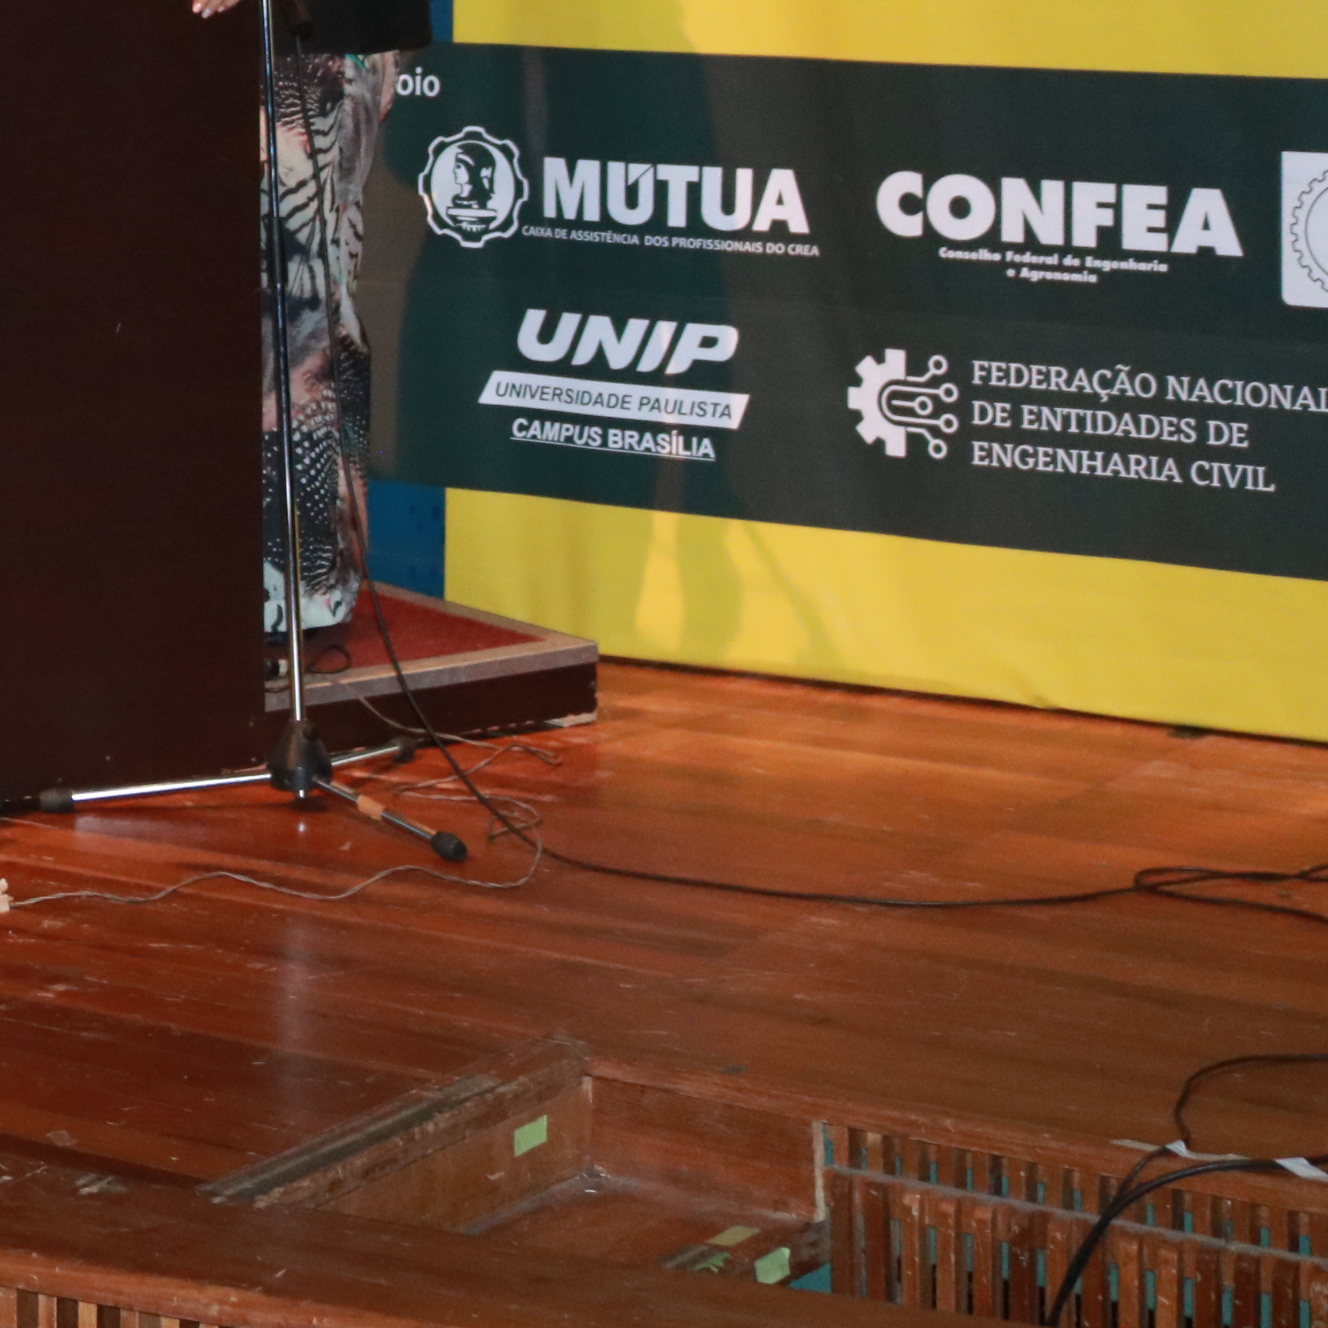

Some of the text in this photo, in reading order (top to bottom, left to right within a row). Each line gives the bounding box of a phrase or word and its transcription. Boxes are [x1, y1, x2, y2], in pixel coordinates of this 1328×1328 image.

[544, 156, 810, 235] MÚTUA
[876, 170, 1243, 257] CONFEA
[522, 225, 820, 257] CAIXA DE ASSISTÊNCIA DOS PROFISSIONAIS DO CREA
[938, 246, 1168, 273] Conselho Federal de Engenharia
[1019, 267, 1097, 283] Agronomia
[517, 308, 739, 375] UNIP
[495, 381, 732, 420] UNIVERSIDADE PAULISTA
[971, 360, 1328, 413] FEDERAÇÃO NACIONAL
[511, 418, 715, 458] CAMPUS BRASÍLIA
[971, 400, 1249, 448] DE ENTIDADES DE
[971, 441, 1275, 492] ENGENHARIA CIVIL
